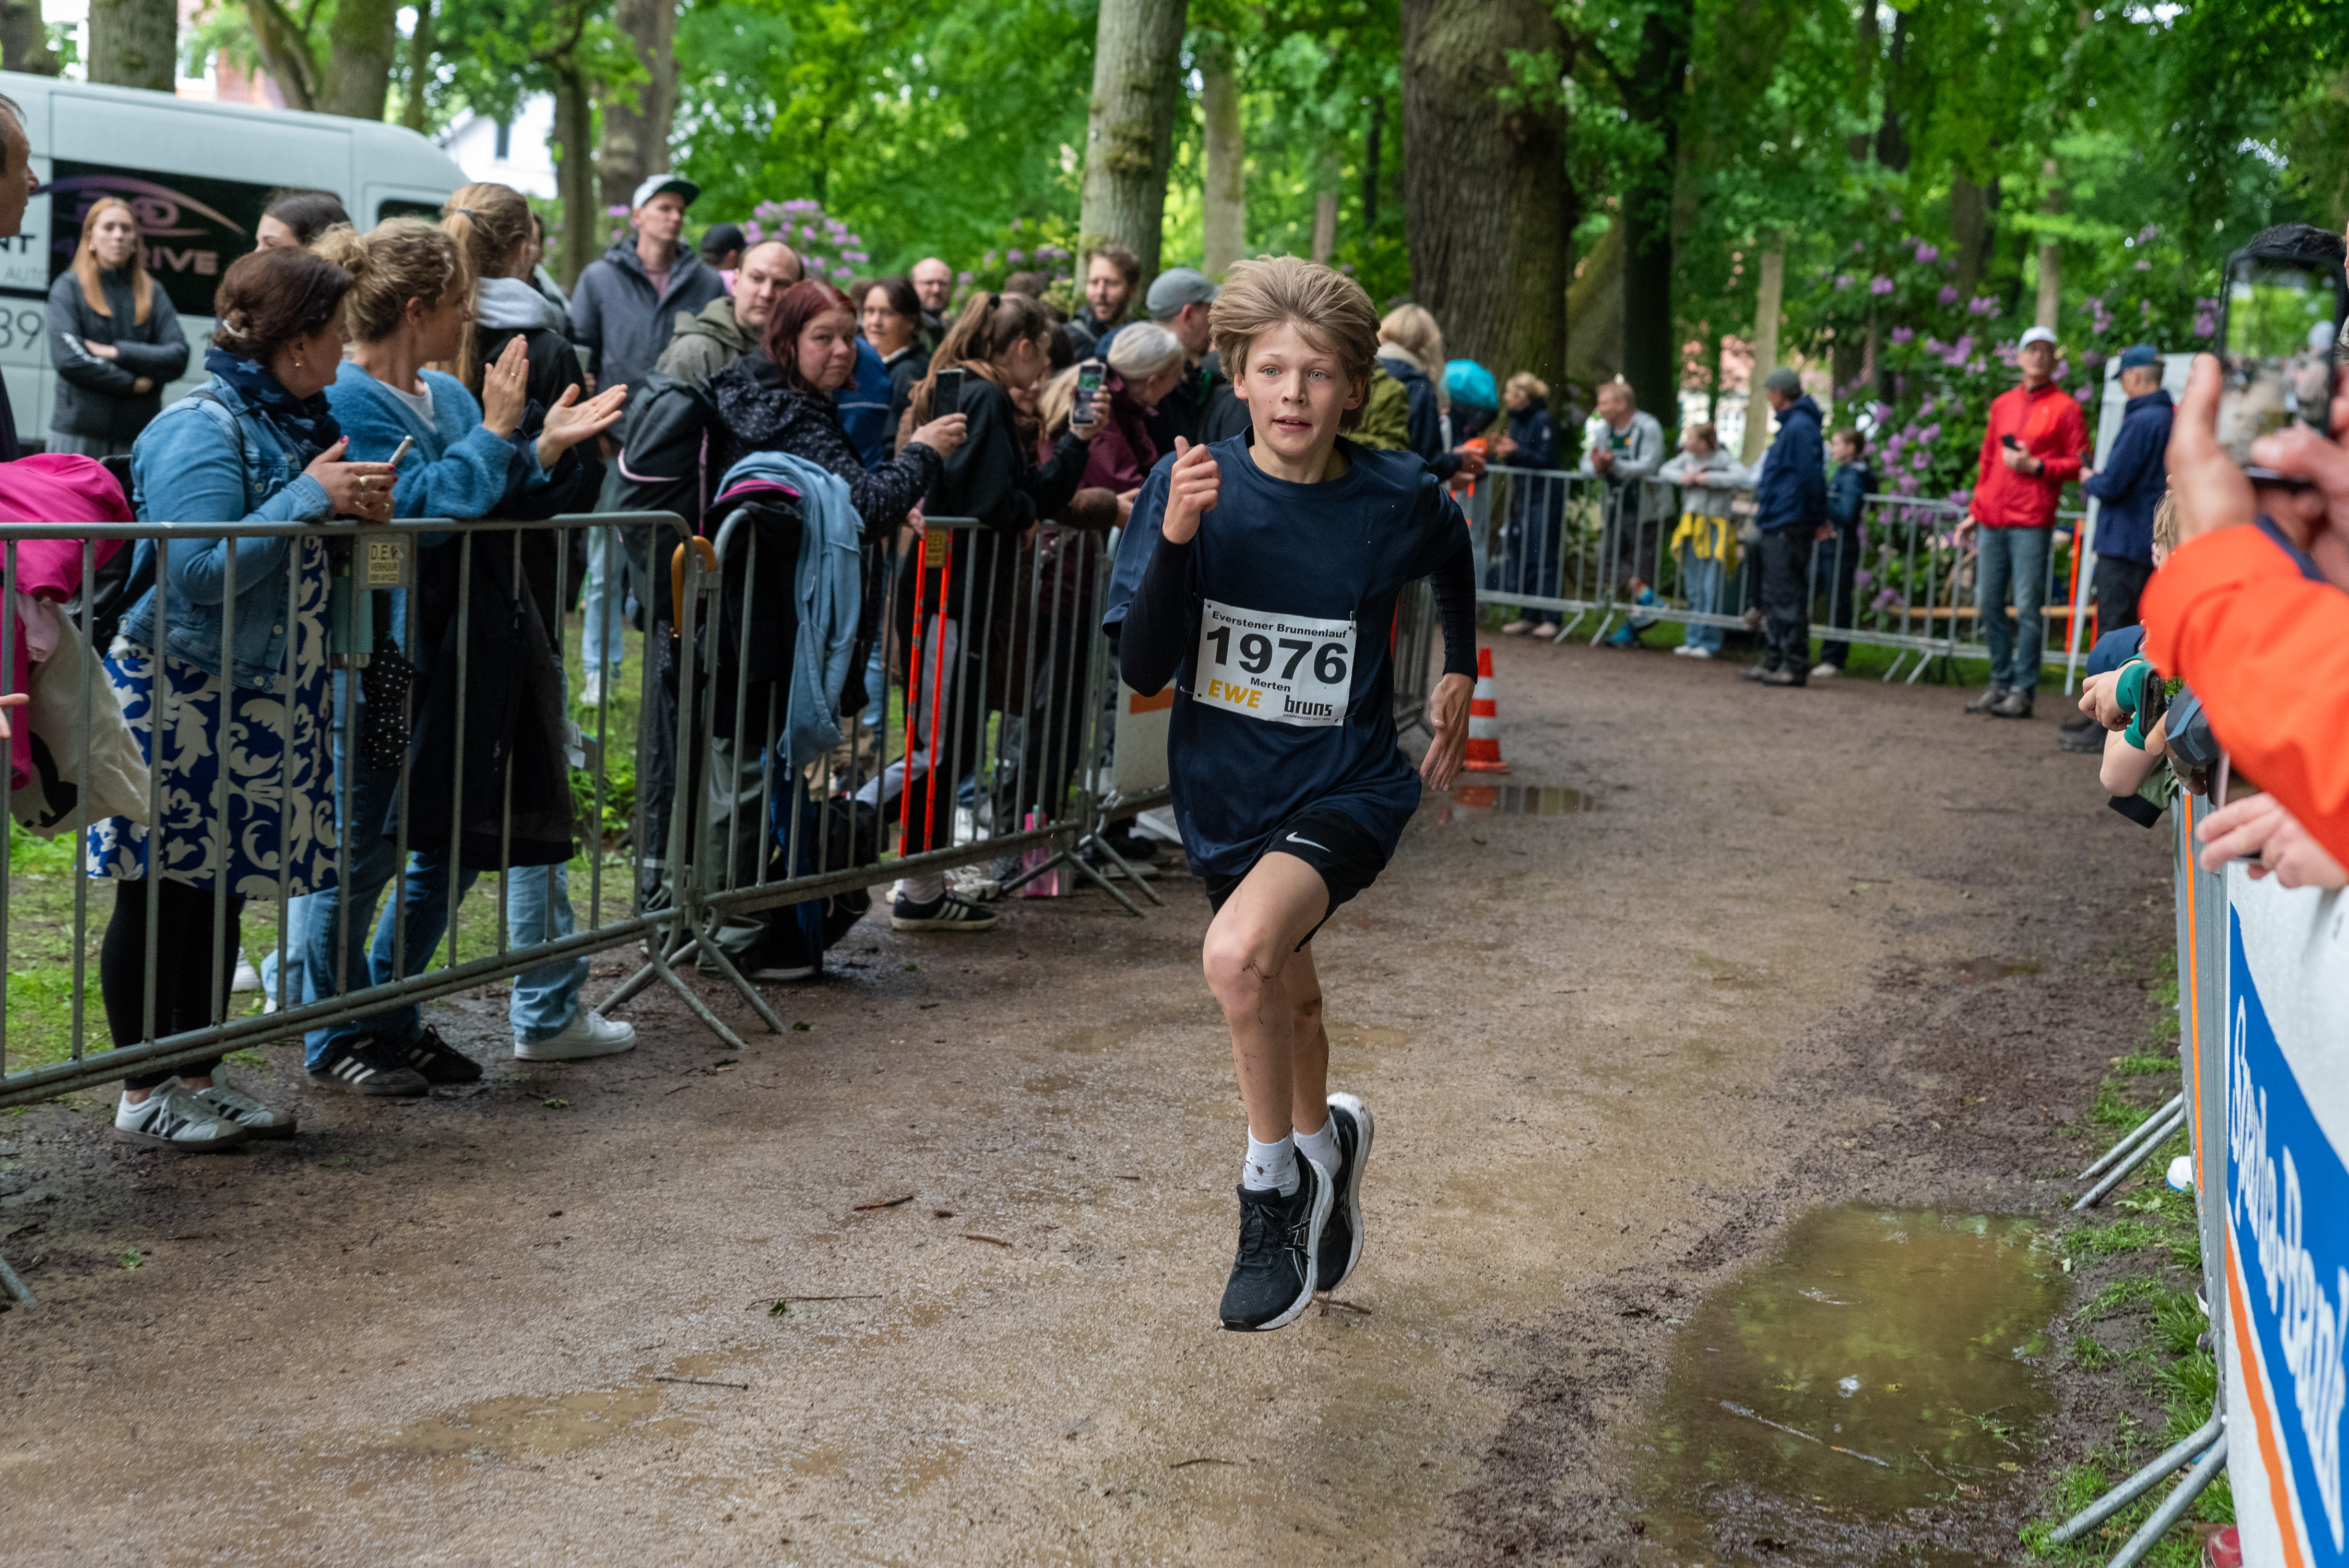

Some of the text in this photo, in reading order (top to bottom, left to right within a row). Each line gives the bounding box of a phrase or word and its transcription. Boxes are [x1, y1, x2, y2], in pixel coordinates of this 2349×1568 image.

[1212, 611, 1347, 638] Everstener Brunnenlauf
[1206, 626, 1348, 684] 1976
[1208, 679, 1333, 716] EWE bruns
[1250, 677, 1291, 692] Merten
[2231, 994, 2349, 1554] Sparda-Bank
